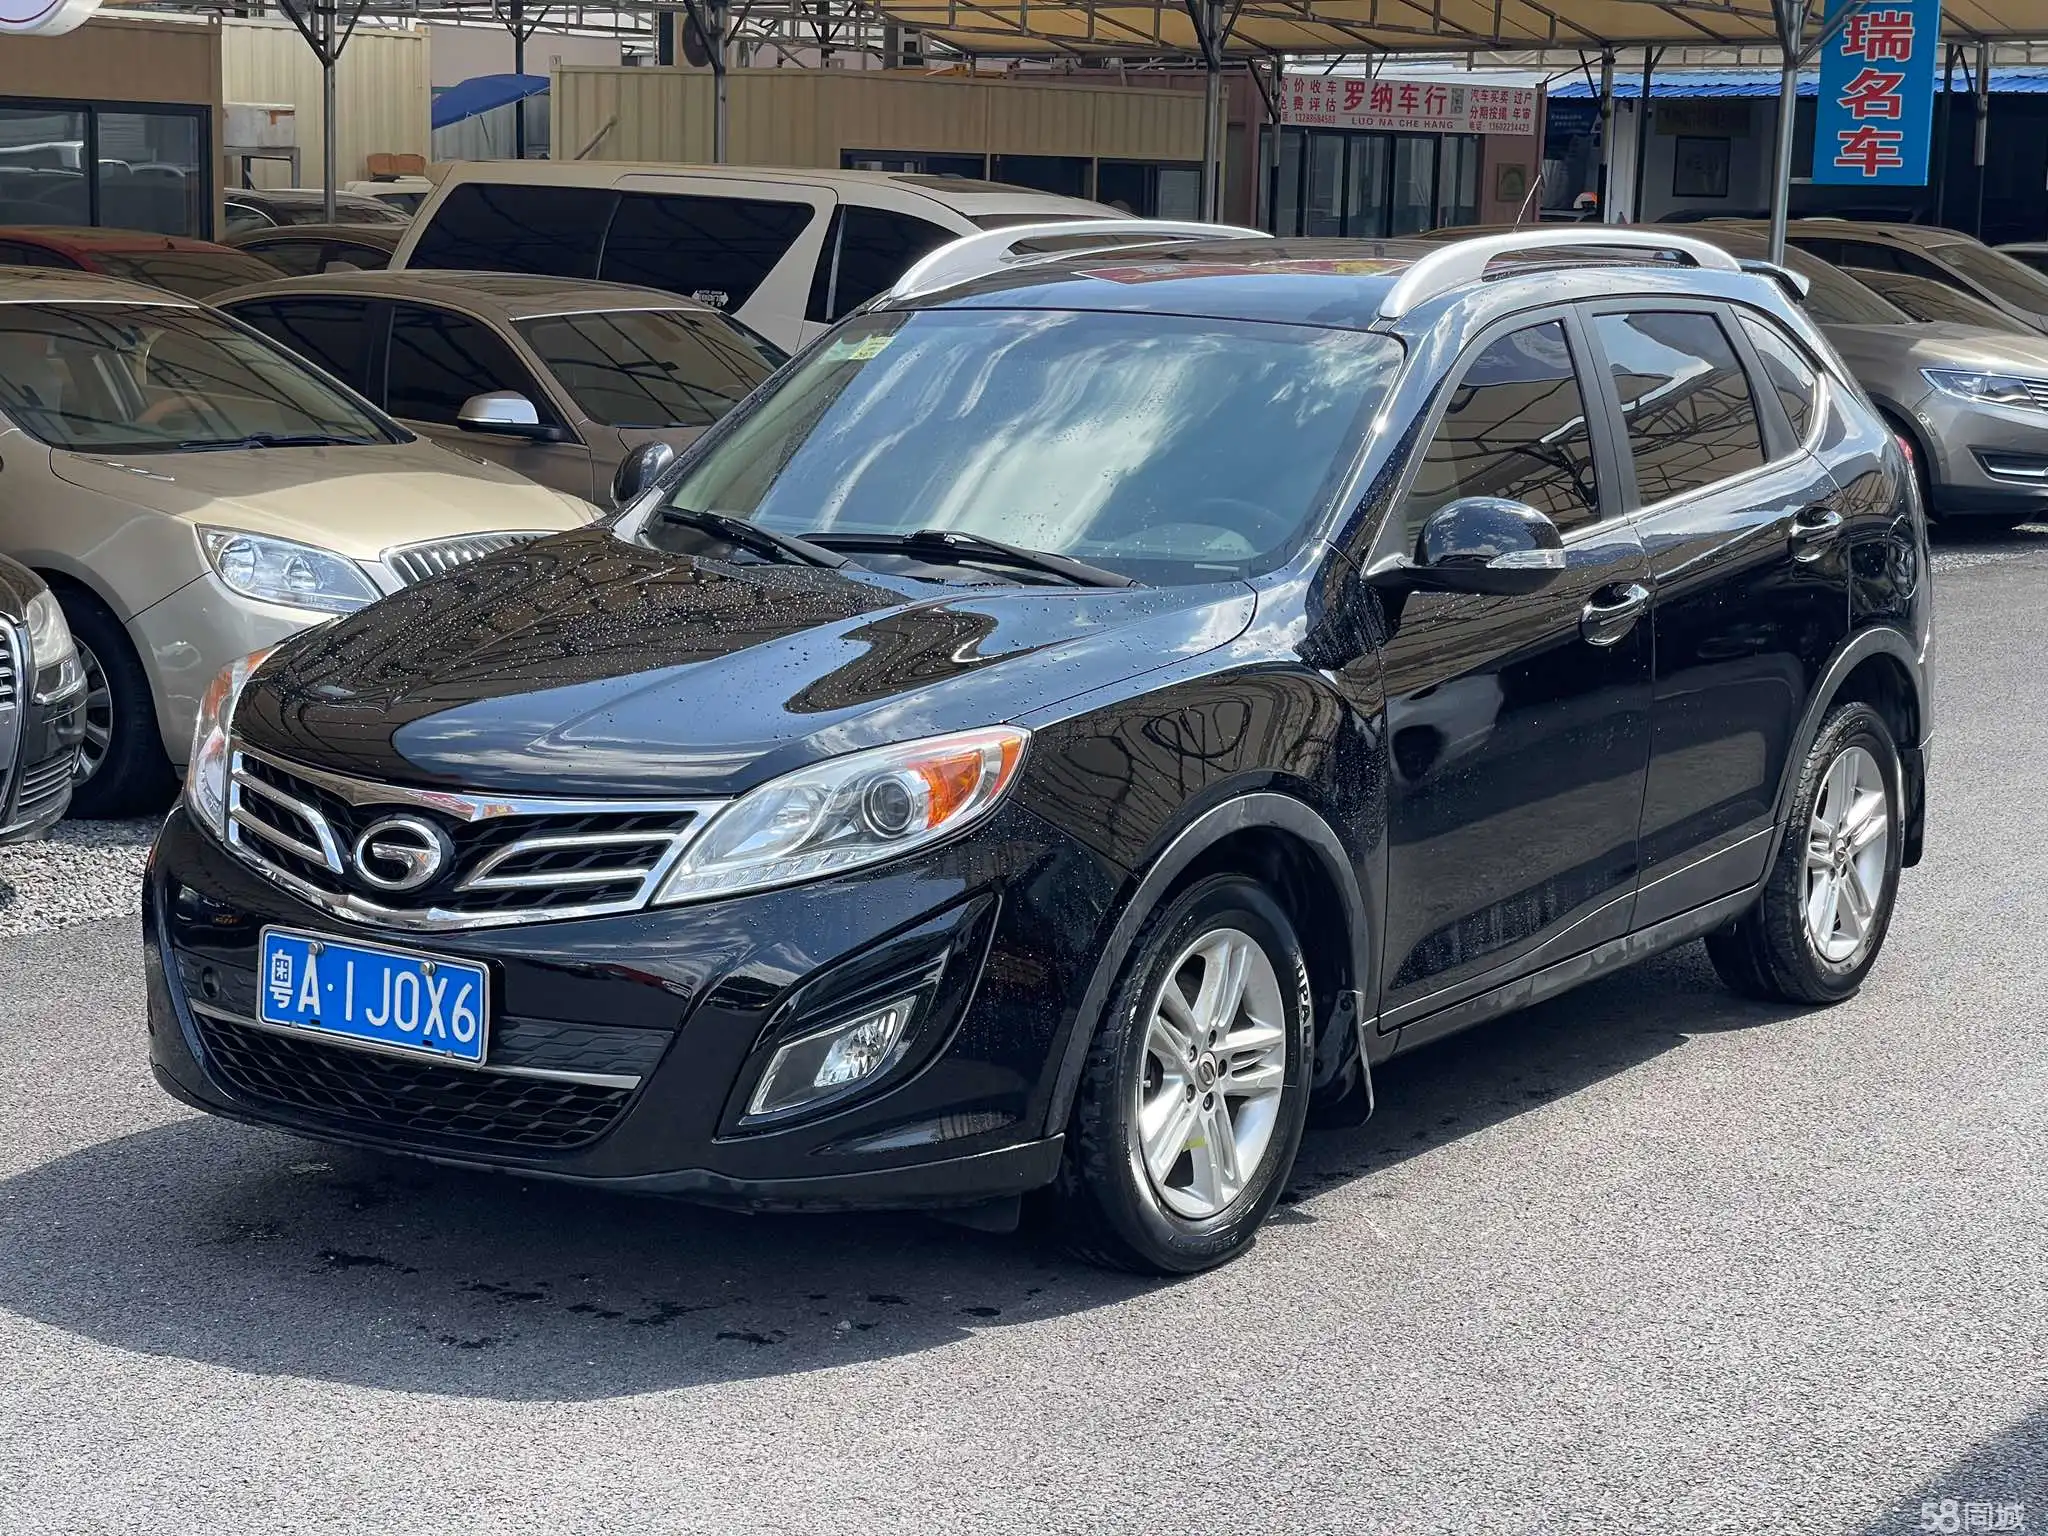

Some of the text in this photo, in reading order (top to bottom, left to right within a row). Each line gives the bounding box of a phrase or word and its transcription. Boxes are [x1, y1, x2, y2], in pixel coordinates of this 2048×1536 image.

[1343, 80, 1447, 115] 罗纳车行
[1470, 88, 1533, 104] 汽车买卖 过户
[1351, 116, 1454, 129] LUO NA CHE HANG
